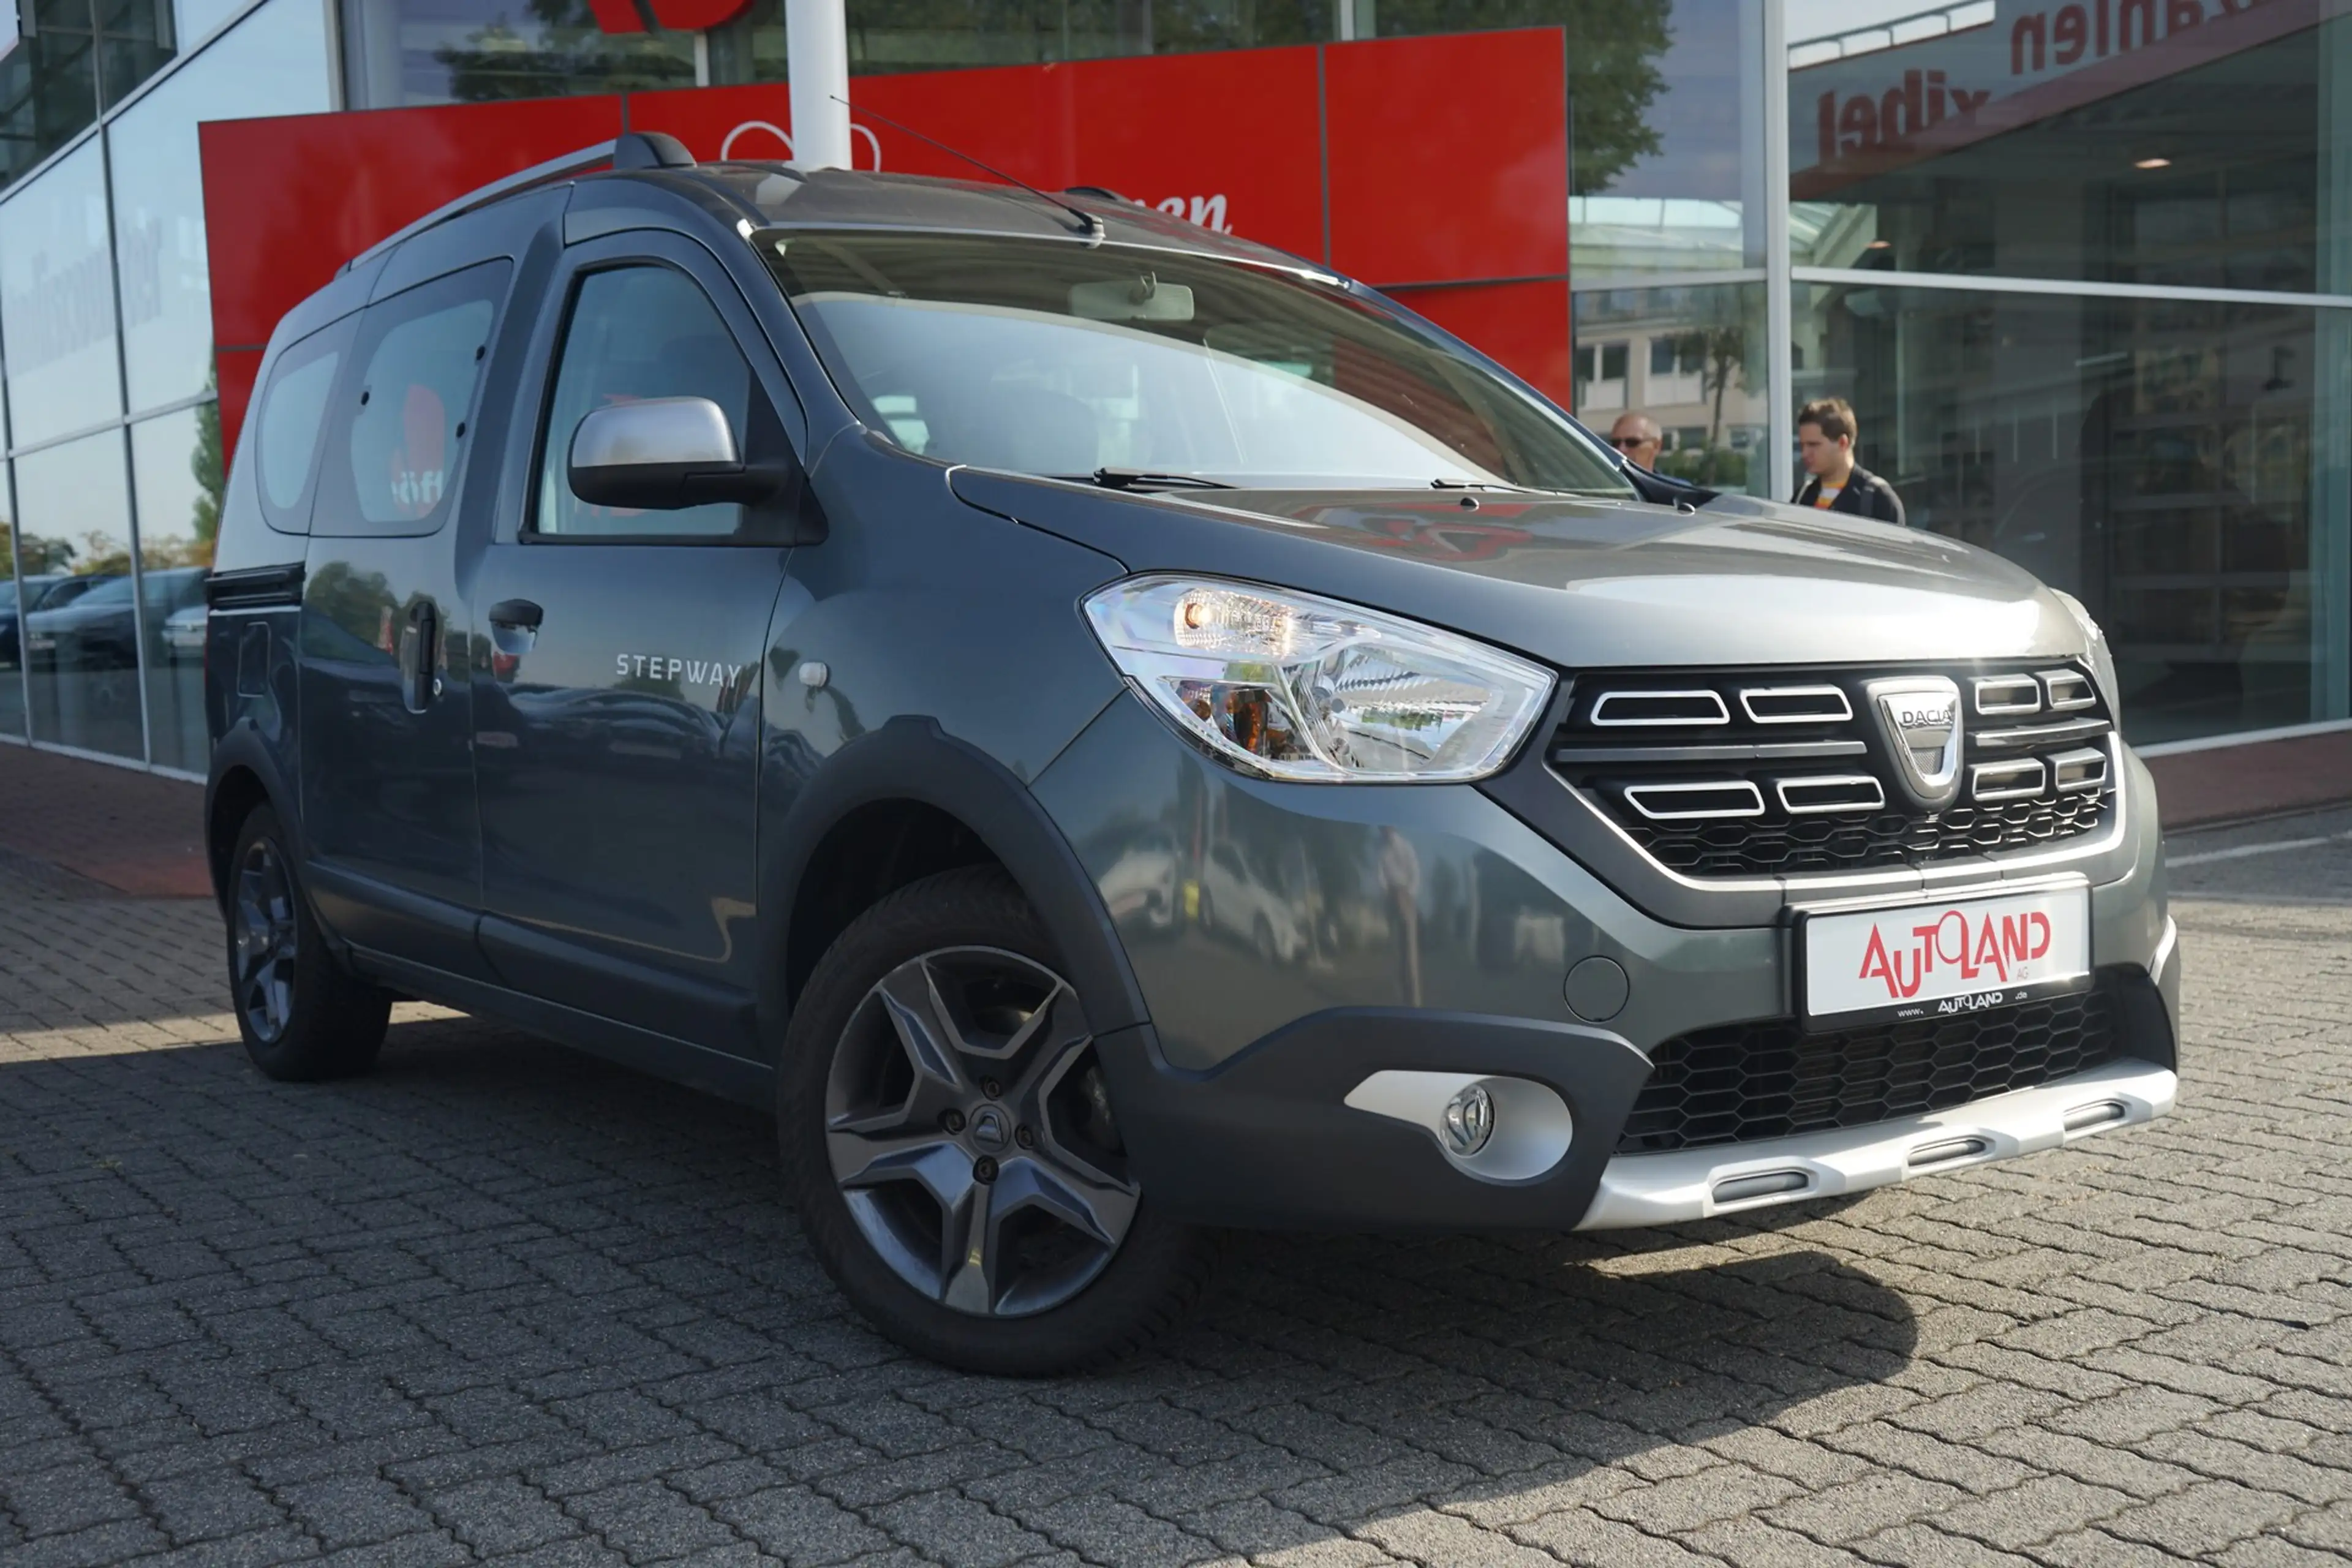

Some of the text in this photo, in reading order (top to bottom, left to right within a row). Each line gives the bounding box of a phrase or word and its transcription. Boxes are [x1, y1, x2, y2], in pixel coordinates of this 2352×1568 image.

[616, 653, 741, 689] STEPWAY
[1901, 709, 1953, 726] DACIA
[1858, 910, 2051, 998] AUTOLAND
[2016, 967, 2029, 981] AG
[1897, 1008, 1924, 1018] www.
[1937, 992, 2003, 1014] AUTOLAND
